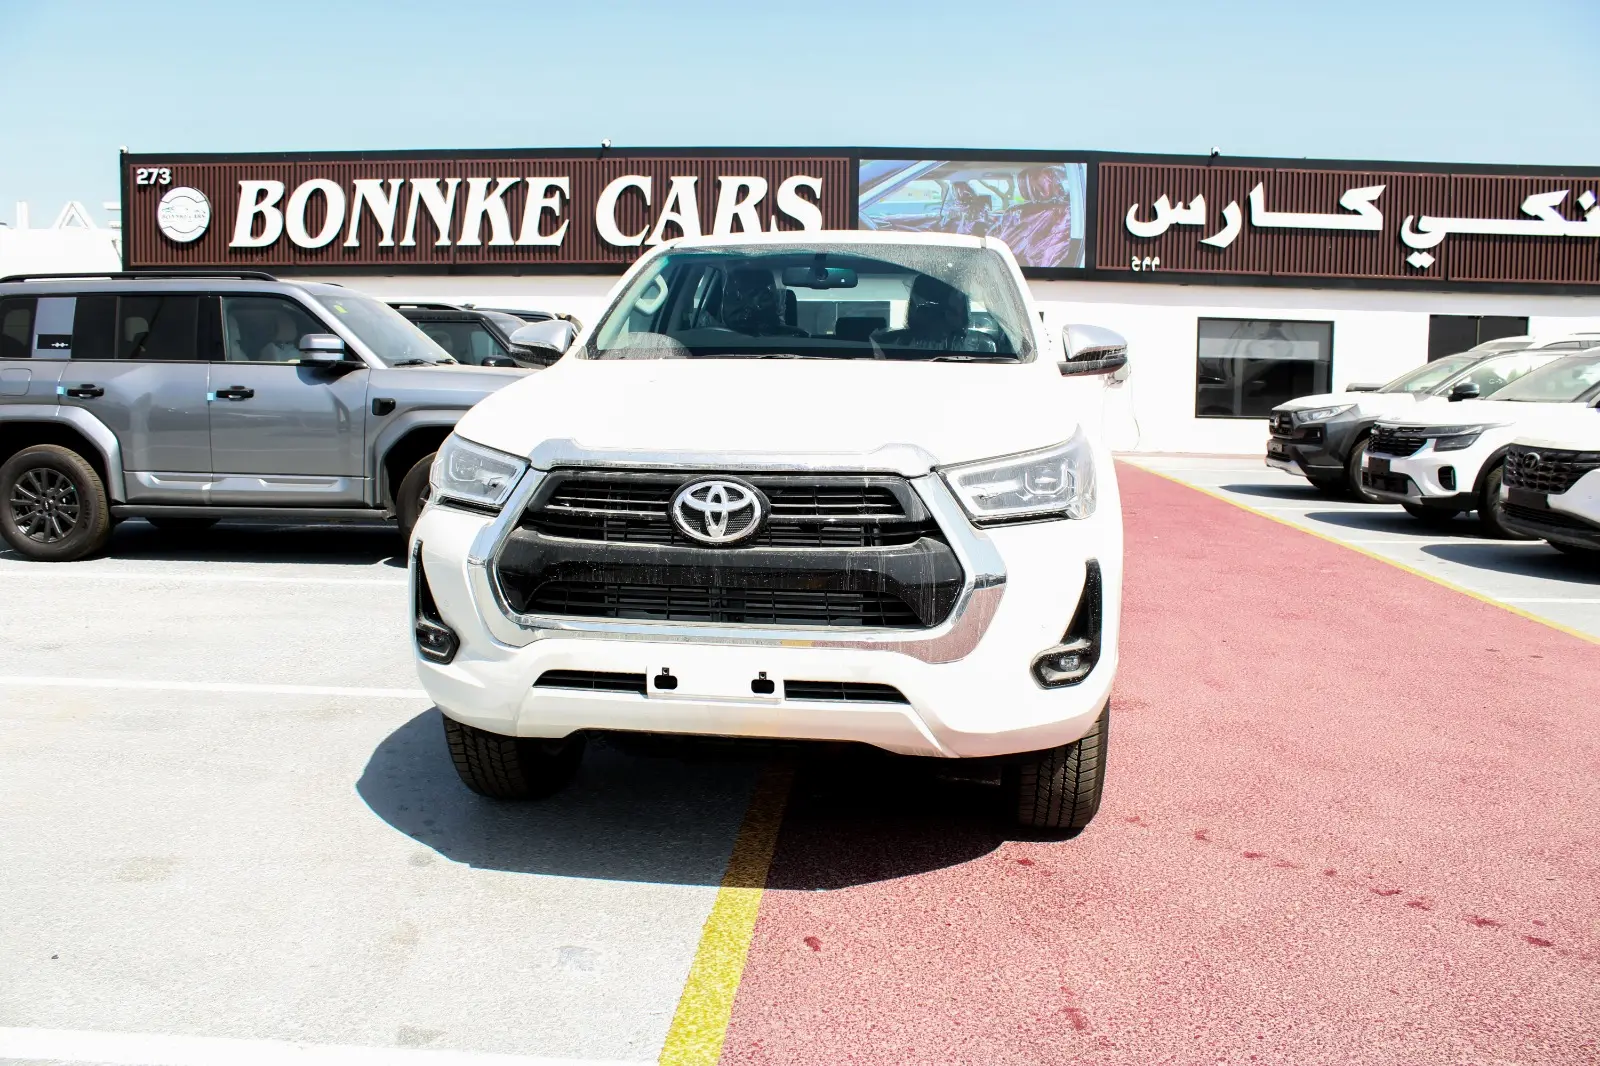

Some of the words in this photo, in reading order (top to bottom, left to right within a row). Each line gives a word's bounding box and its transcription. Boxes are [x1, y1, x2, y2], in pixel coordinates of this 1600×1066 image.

[136, 167, 171, 185] 273
[228, 176, 570, 249] BONNKE
[595, 174, 823, 247] CARS
[1125, 181, 1386, 248] كارس
